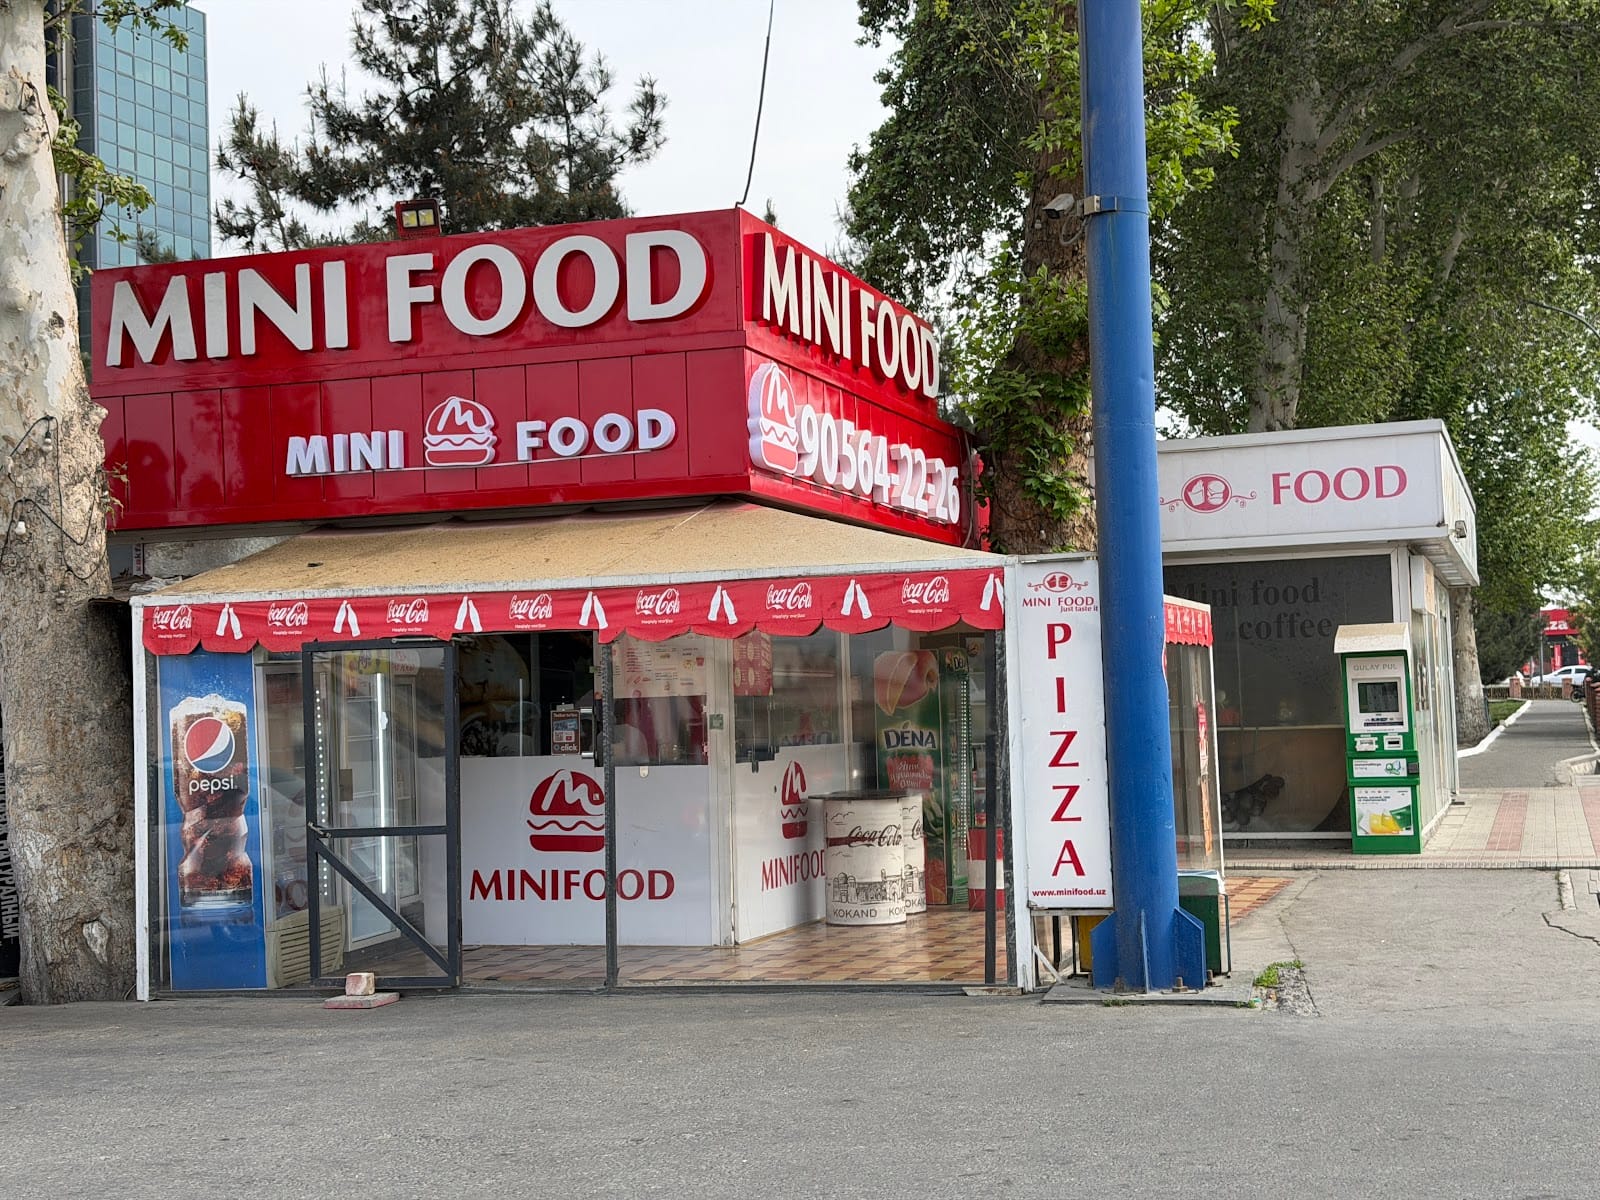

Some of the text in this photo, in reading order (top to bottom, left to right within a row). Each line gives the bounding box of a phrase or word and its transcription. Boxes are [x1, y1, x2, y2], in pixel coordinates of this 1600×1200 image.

[105, 229, 708, 368] MINI FOOD
[762, 231, 940, 399] MINI FOOD
[285, 408, 676, 477] MINI FOOD
[1271, 465, 1408, 505] FOOD
[1022, 595, 1095, 609] MINI FOOD
[1167, 577, 1321, 607] Mini food
[1075, 605, 1090, 613] taste
[1238, 611, 1333, 640] coffee
[1382, 663, 1398, 671] PUL
[1046, 622, 1086, 878] PIZZA
[188, 775, 235, 795] pepsi
[470, 869, 675, 901] MINIFOOD
[1032, 887, 1107, 898] www.minifood.uz
[833, 907, 878, 919] KOKAND
